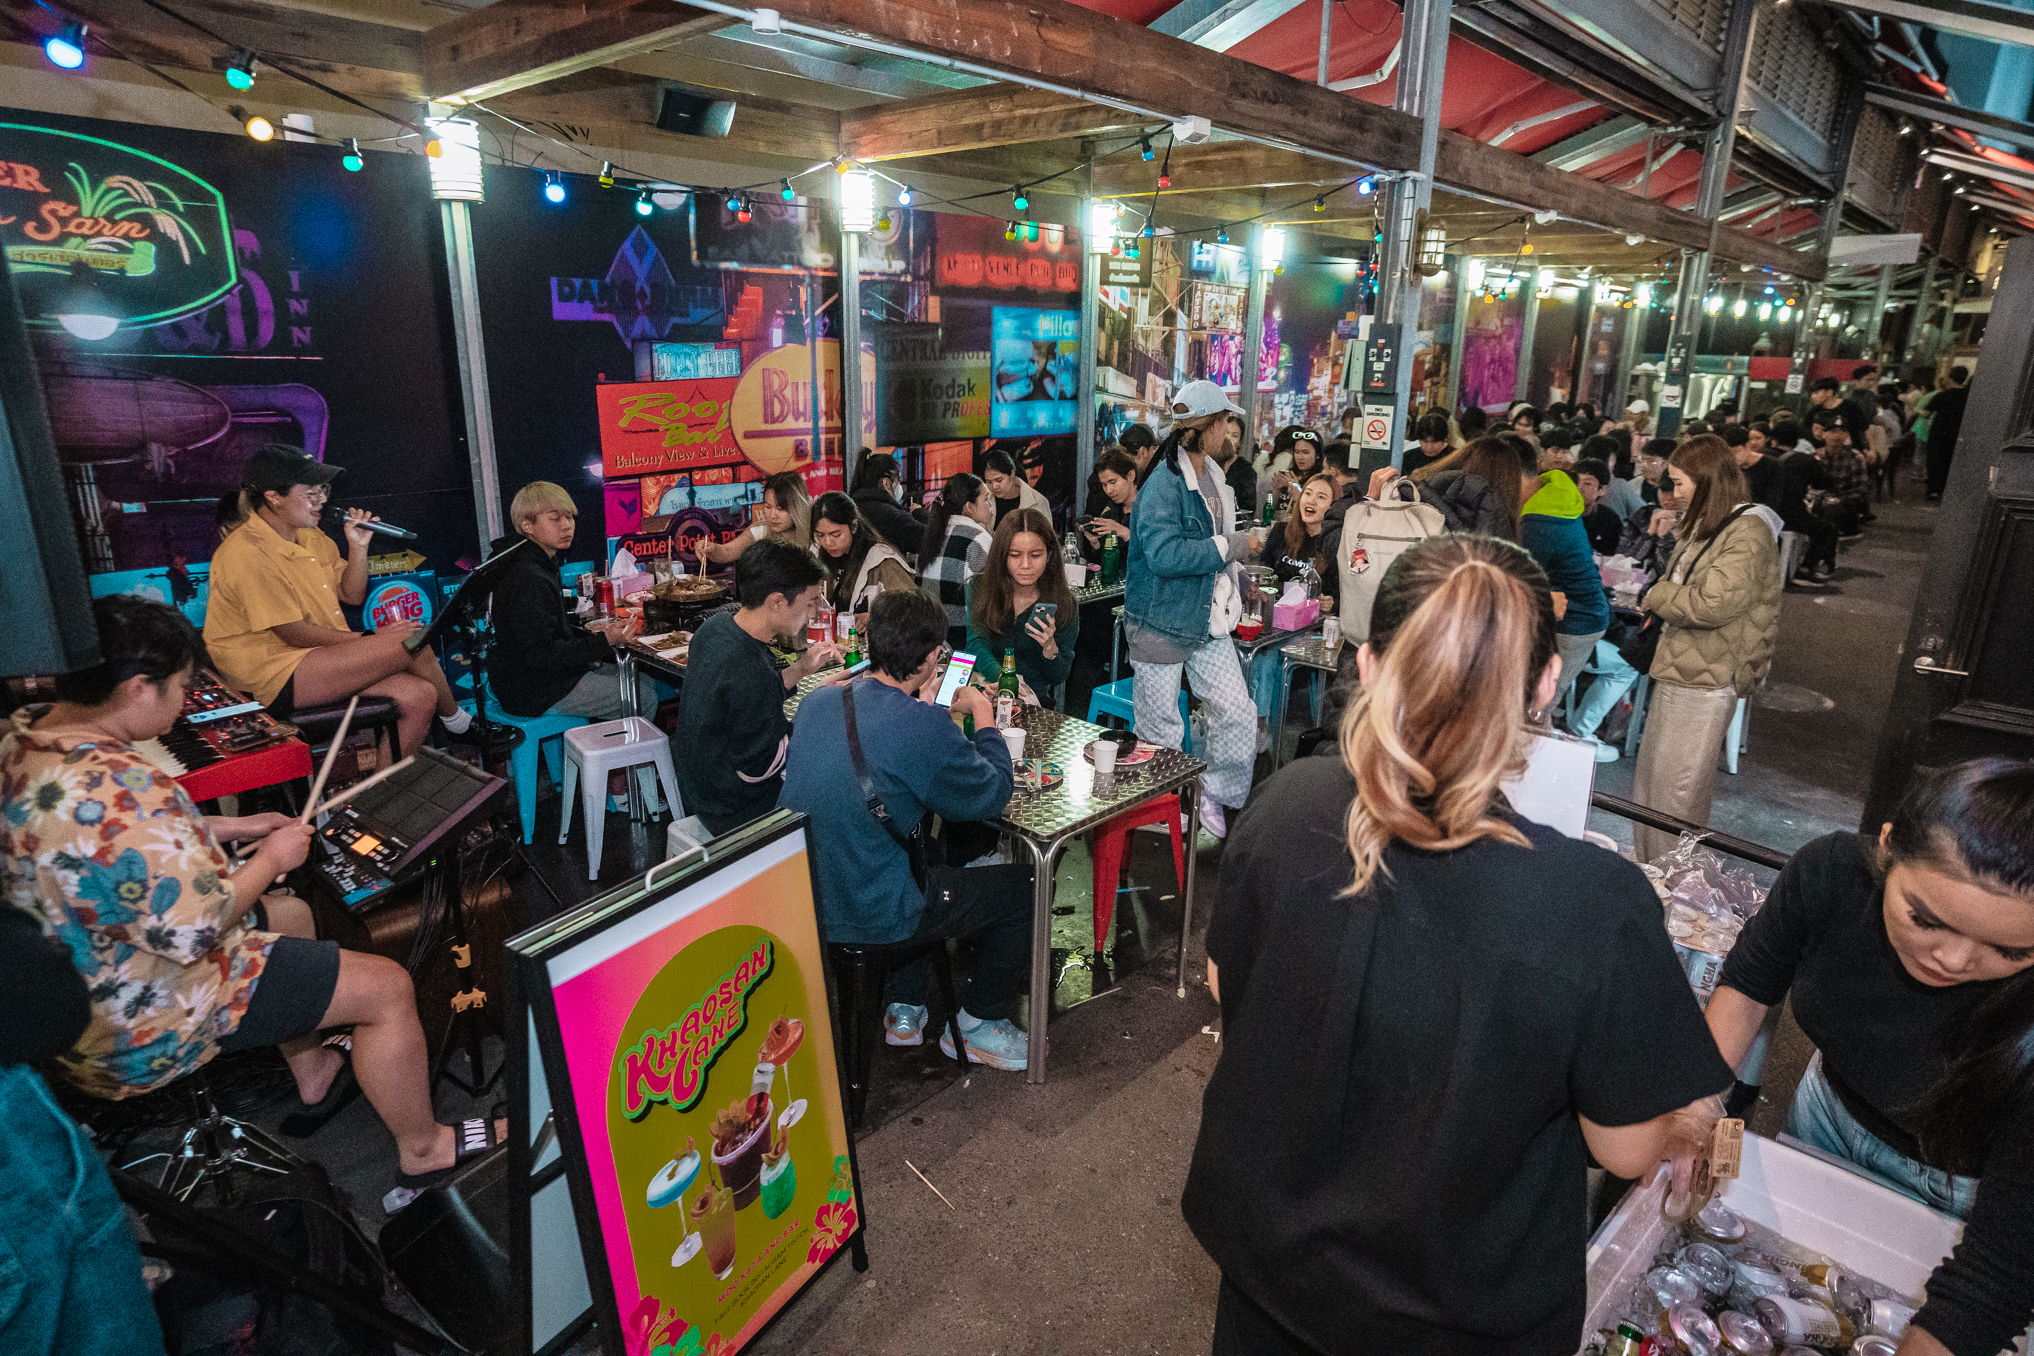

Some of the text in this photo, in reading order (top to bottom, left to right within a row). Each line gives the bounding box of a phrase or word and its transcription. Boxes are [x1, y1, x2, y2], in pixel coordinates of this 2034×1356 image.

[23, 201, 150, 241] Sarn
[1039, 314, 1079, 338] Pillo
[1193, 283, 1203, 329] TATTOO
[920, 378, 977, 400] Kodak
[615, 445, 736, 468] Balcony View & Live
[659, 424, 722, 447] Bar
[623, 536, 675, 557] Center
[626, 943, 766, 1111] KHAOSAN
[673, 1001, 740, 1102] LANE
[717, 1219, 800, 1306] MOO KATA AND BAR
[740, 1256, 788, 1308] KHAOSAN LANE
[714, 1286, 749, 1324] FACEBOOK
[750, 1248, 786, 1287] INSTAGRAM
